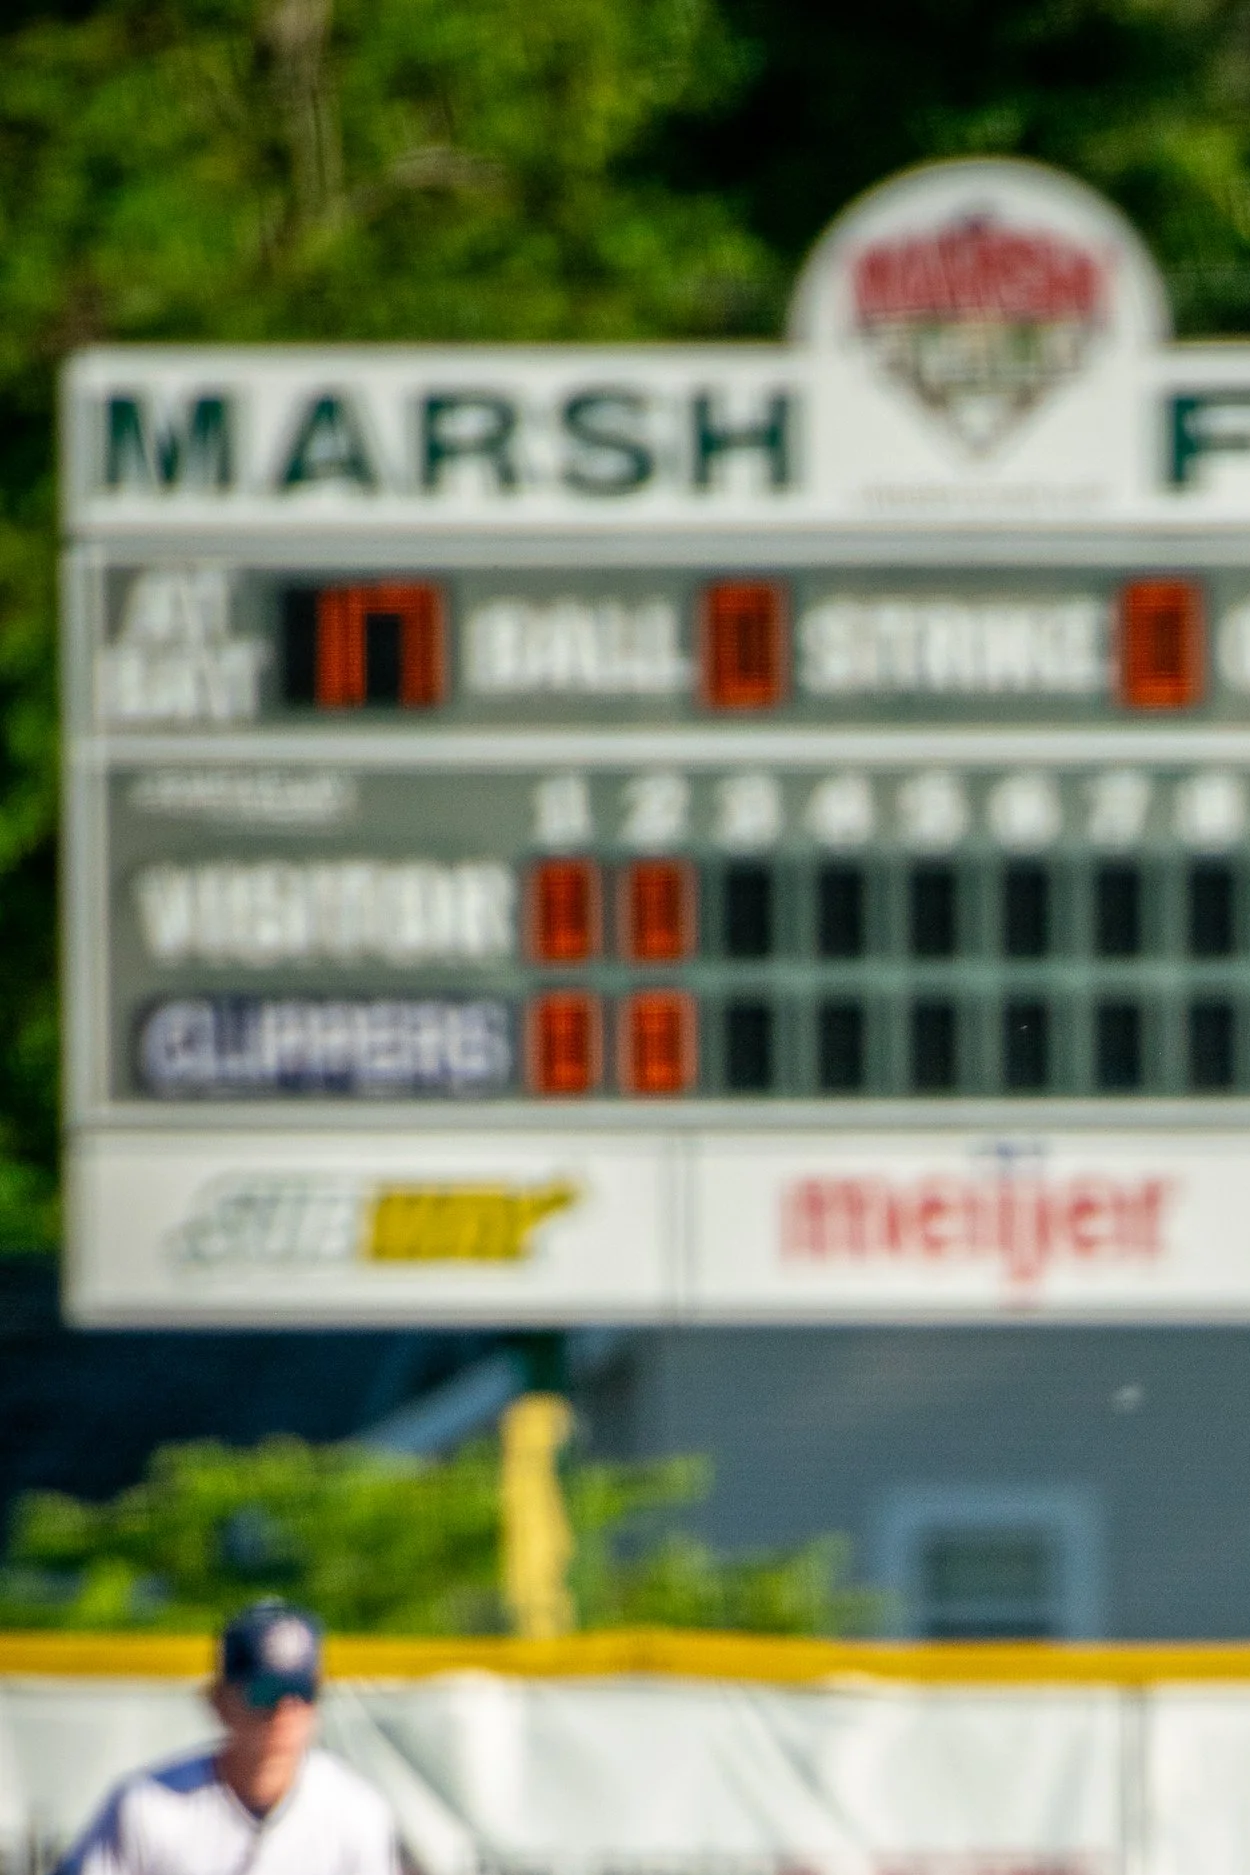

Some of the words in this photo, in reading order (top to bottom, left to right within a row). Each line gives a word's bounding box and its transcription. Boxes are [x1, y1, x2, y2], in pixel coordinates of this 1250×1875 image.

[103, 388, 792, 492] MARSH
[462, 598, 690, 696] BALL
[796, 598, 1102, 696] STRIKE
[535, 772, 592, 846] 1
[622, 772, 690, 846] 2
[715, 772, 785, 846] 3
[1088, 772, 1152, 846] 7
[134, 862, 518, 962] VISITOR
[140, 1002, 516, 1092] CLIPPERS
[780, 1158, 1178, 1302] meijer
